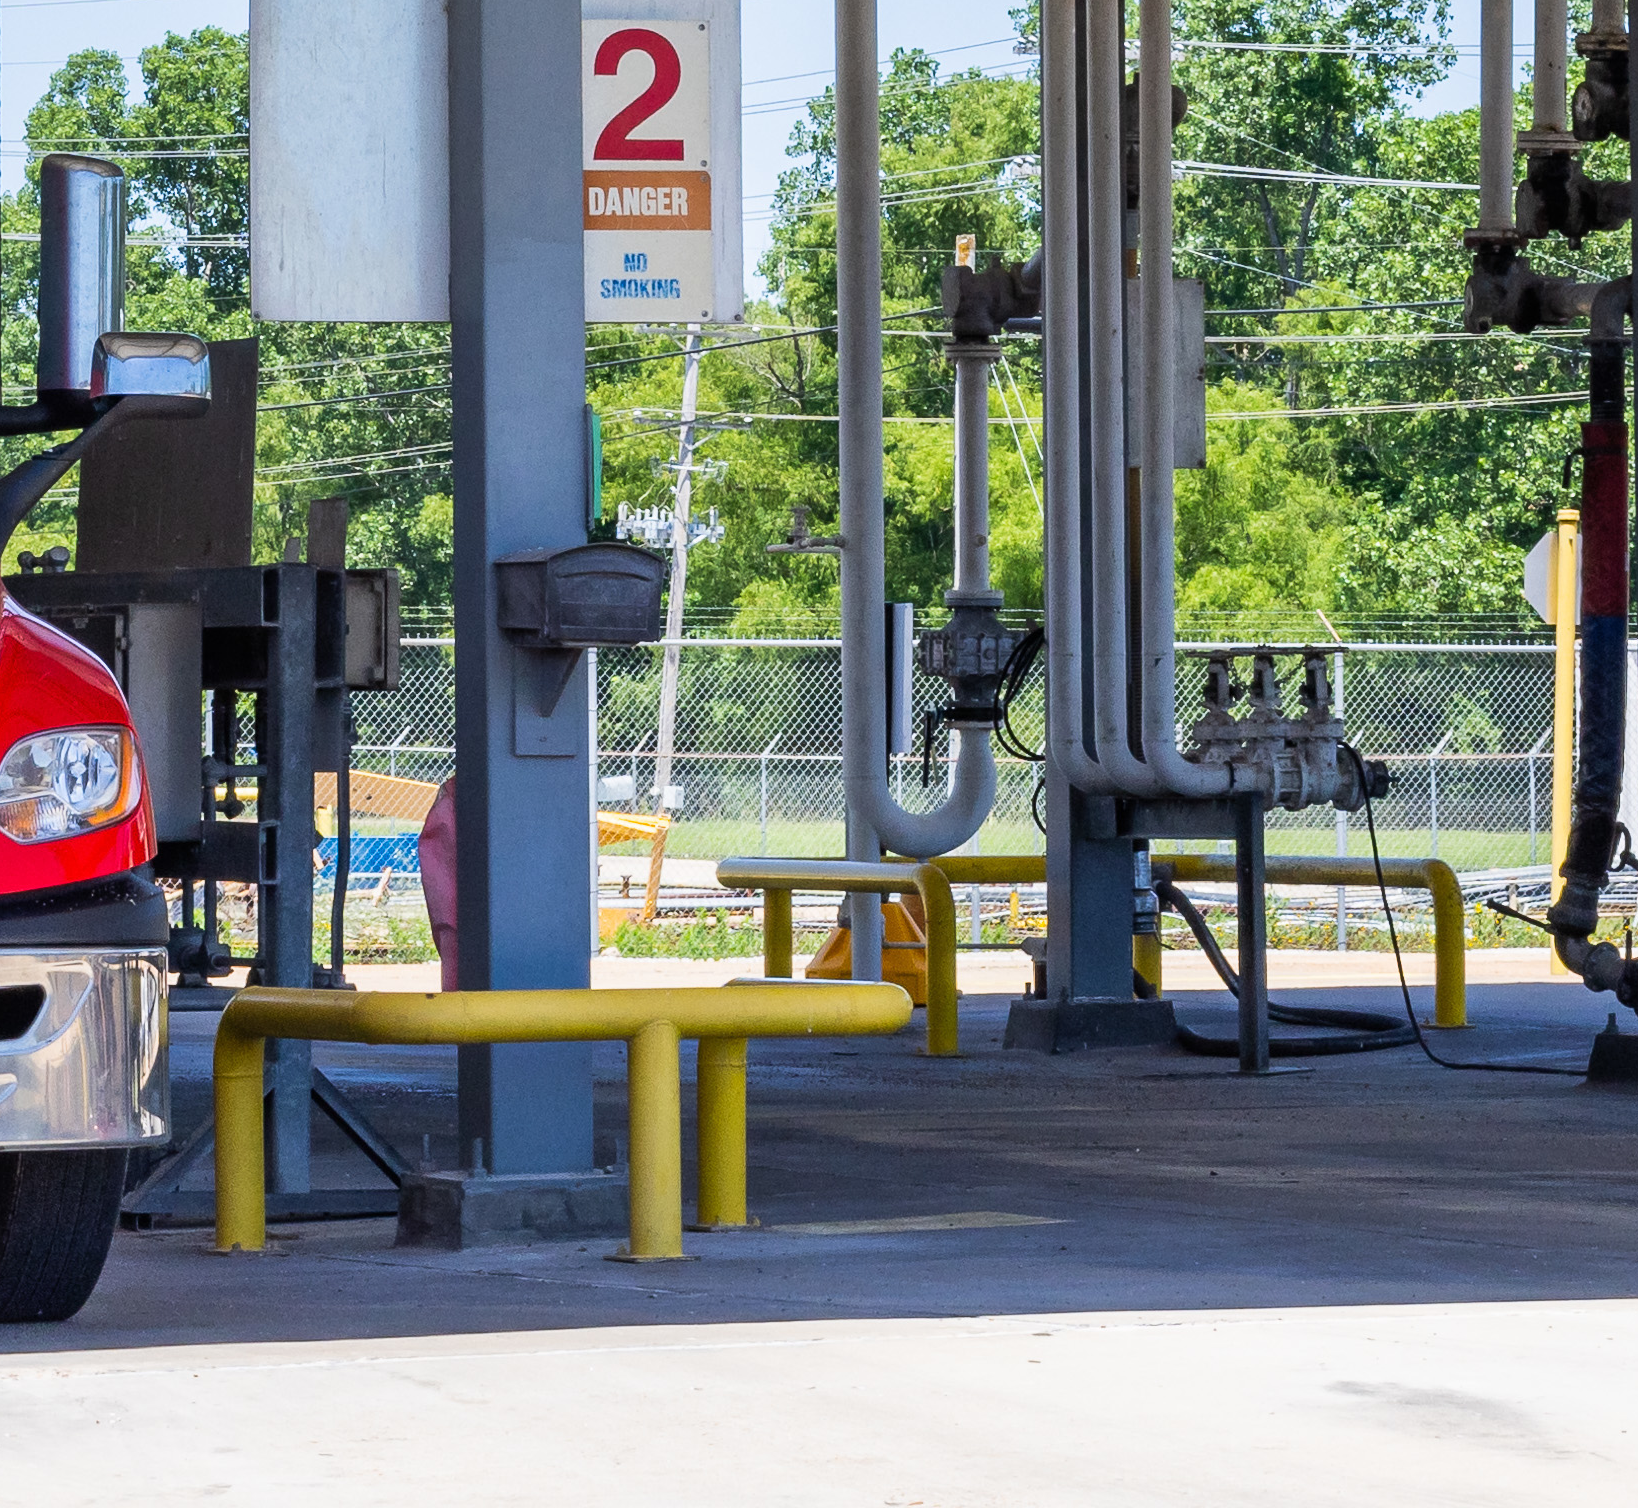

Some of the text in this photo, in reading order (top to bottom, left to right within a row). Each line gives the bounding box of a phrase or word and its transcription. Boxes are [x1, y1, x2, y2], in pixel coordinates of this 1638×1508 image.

[594, 28, 684, 161] 2
[588, 187, 688, 216] DANGER
[623, 253, 648, 272] NO
[600, 279, 680, 299] SMOKING
